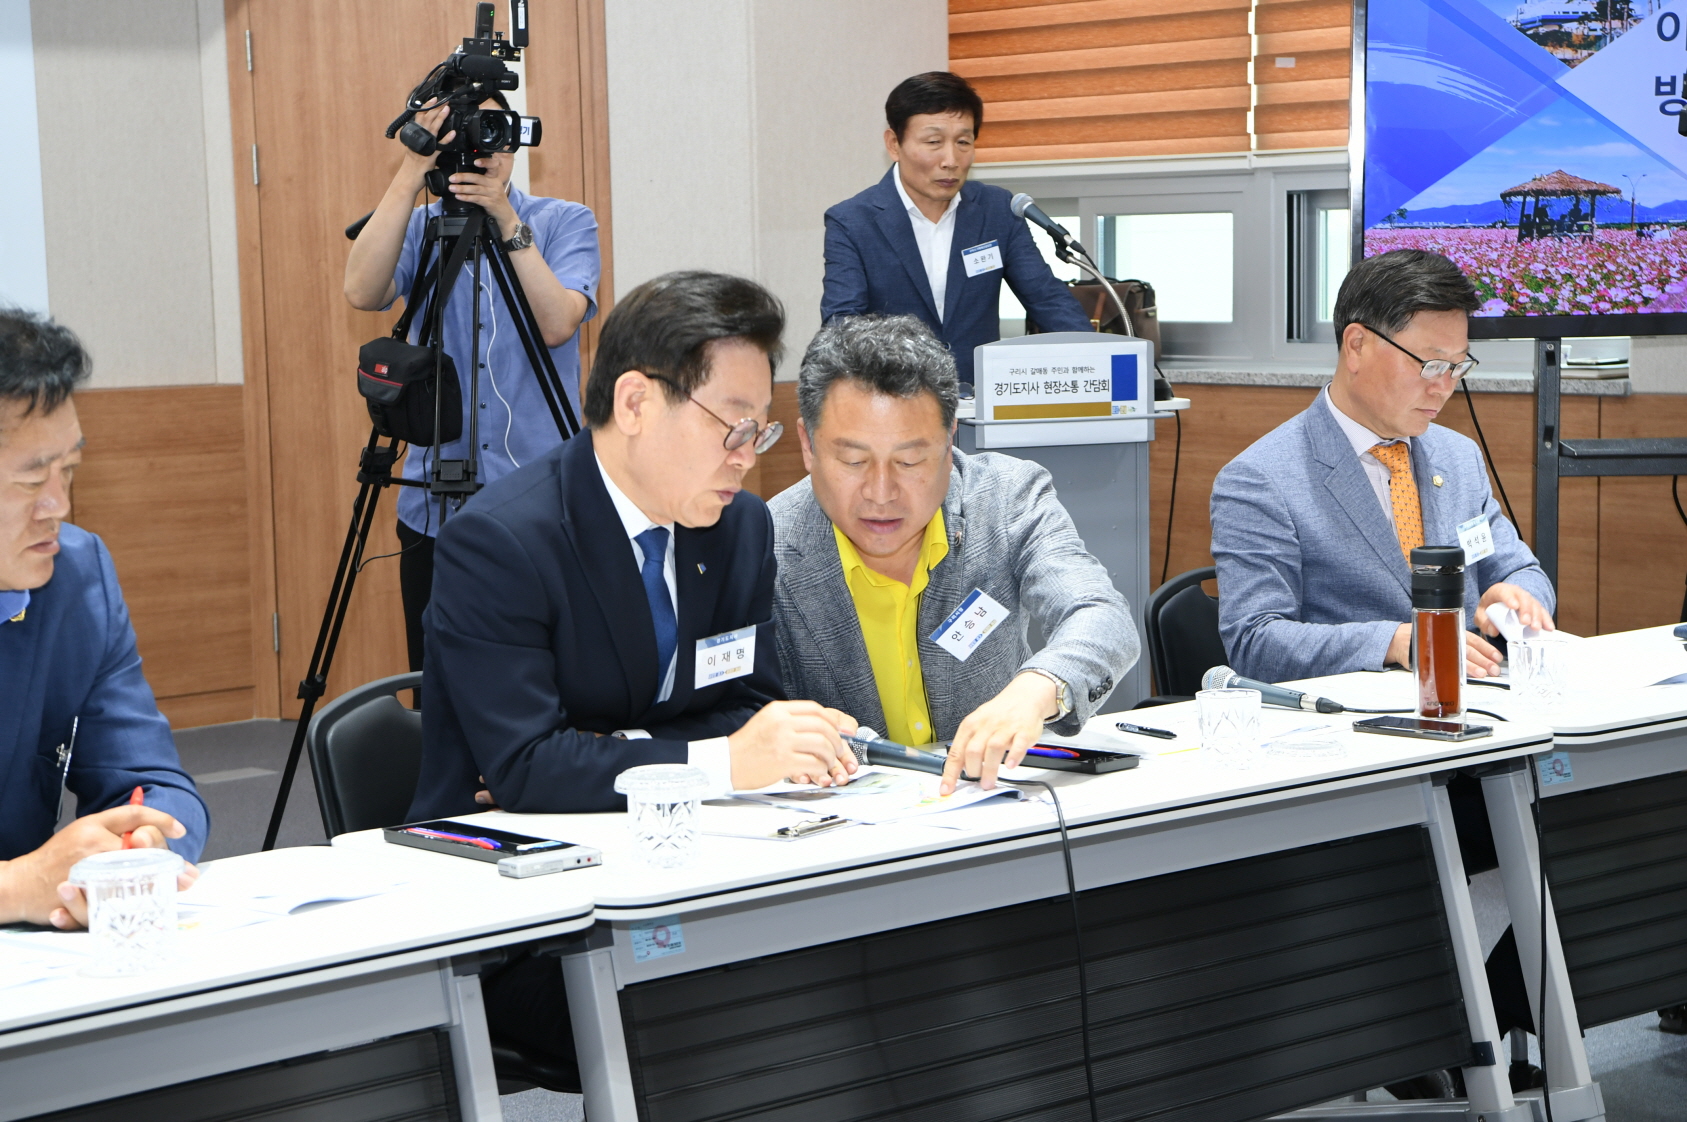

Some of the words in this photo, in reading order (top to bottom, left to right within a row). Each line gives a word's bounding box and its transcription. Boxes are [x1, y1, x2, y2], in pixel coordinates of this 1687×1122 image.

[1009, 368, 1027, 376] 구리시
[1030, 367, 1048, 376] 갈매동
[1072, 366, 1095, 374] 함께하는
[994, 381, 1040, 396] 경기도지사
[1043, 380, 1080, 395] 현장소통
[1083, 378, 1110, 393] 간담회
[951, 606, 987, 641] 안승남
[707, 647, 744, 666] 이재명
